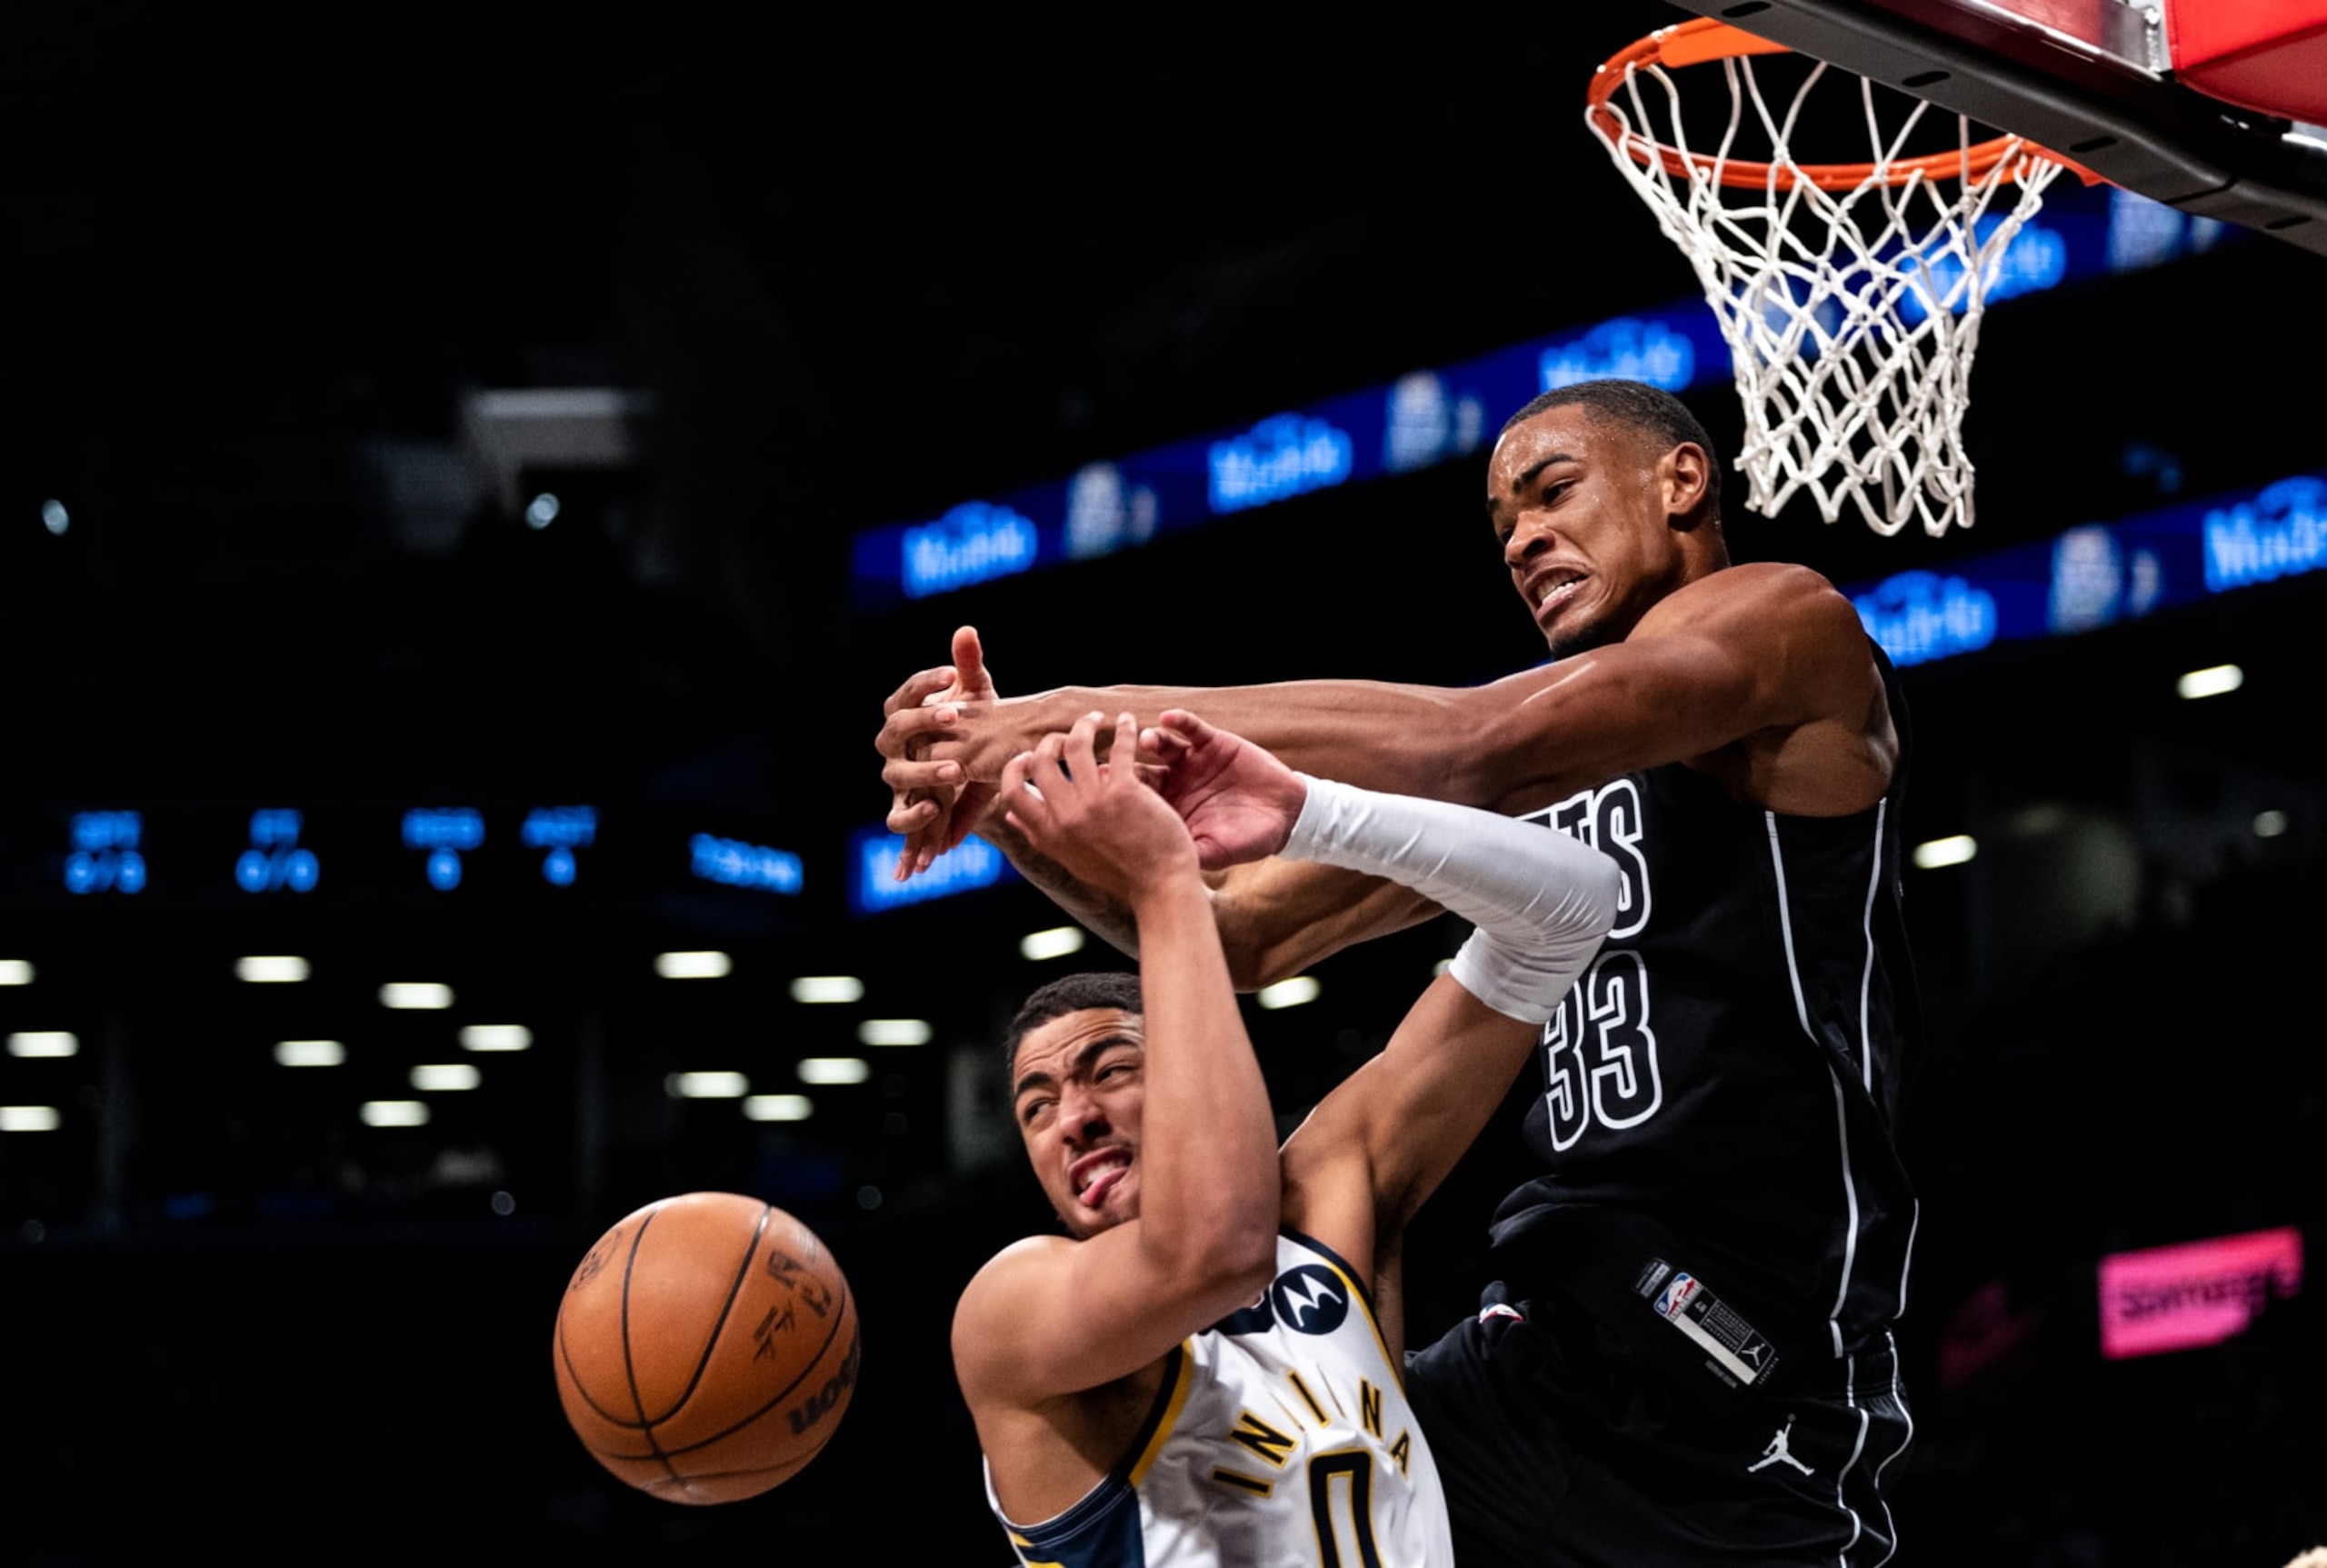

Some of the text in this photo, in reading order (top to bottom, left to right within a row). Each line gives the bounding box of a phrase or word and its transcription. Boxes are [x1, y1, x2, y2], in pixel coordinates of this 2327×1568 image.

[1513, 779, 1652, 940] TS
[1543, 950, 1663, 1152] 33
[1211, 1370, 1411, 1499] ININA
[1307, 1445, 1385, 1568] 0
